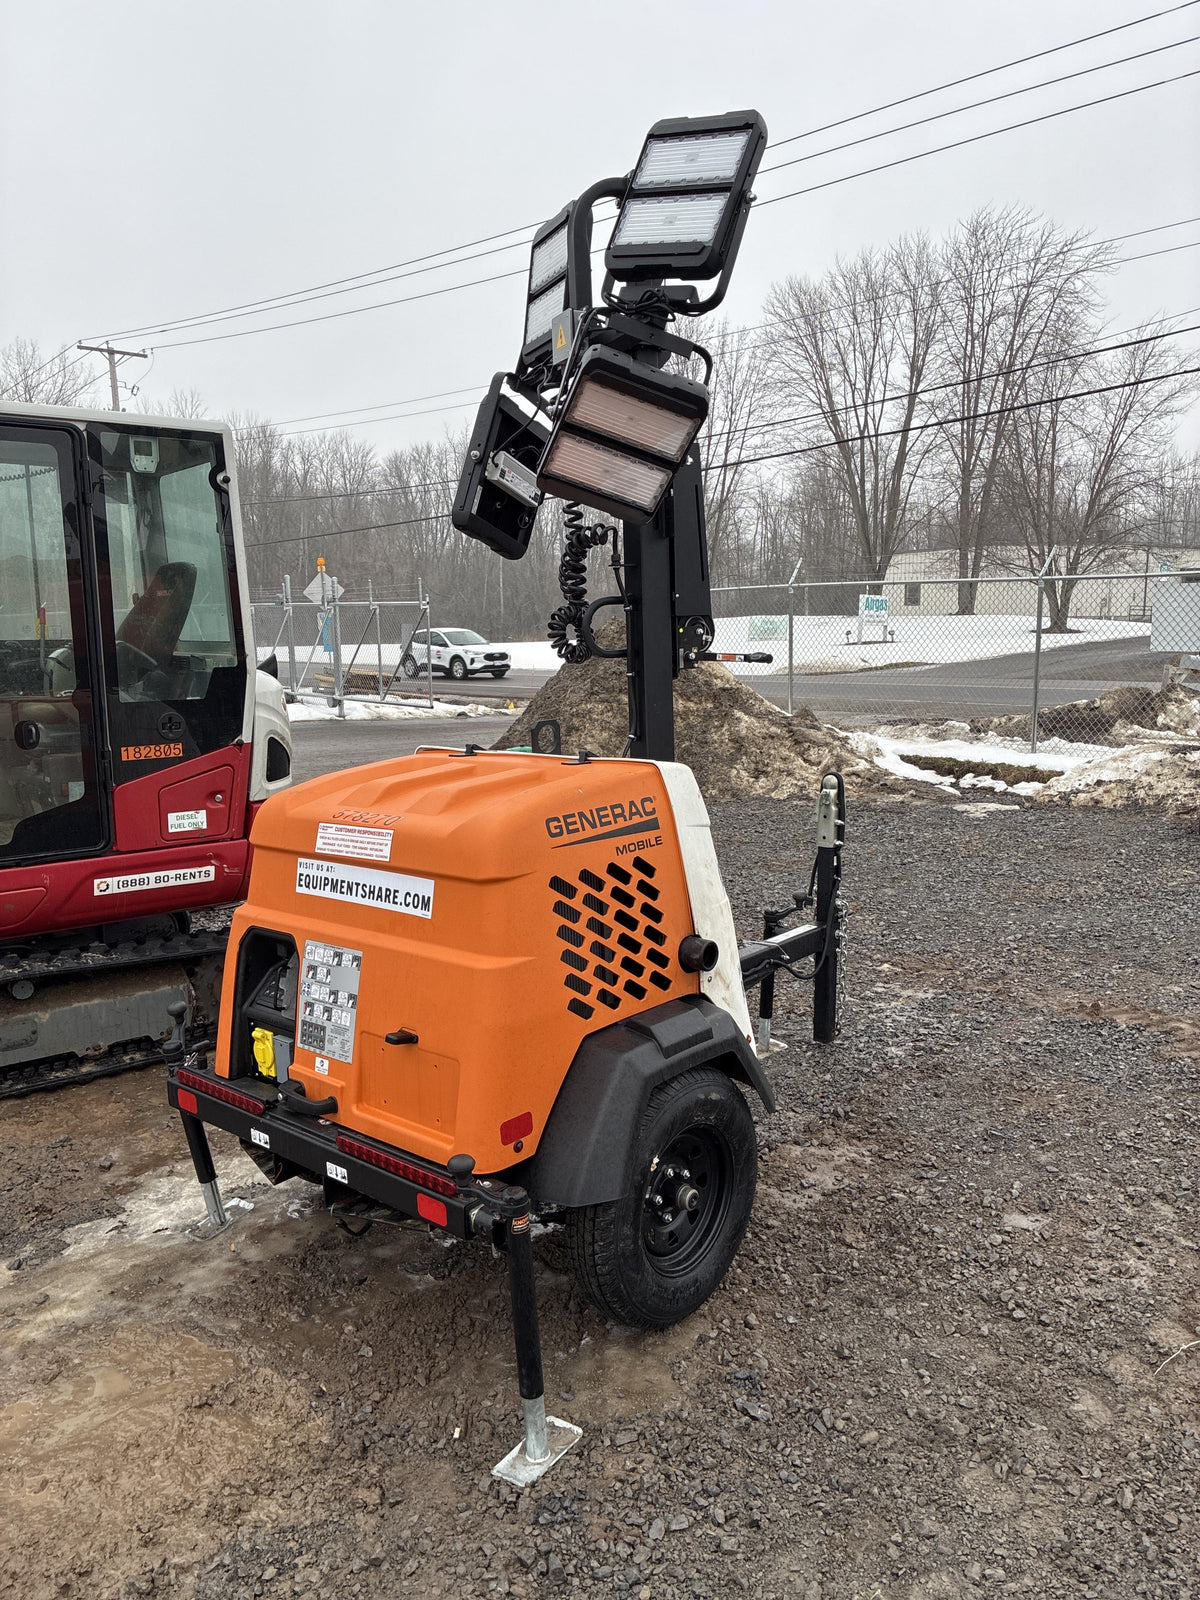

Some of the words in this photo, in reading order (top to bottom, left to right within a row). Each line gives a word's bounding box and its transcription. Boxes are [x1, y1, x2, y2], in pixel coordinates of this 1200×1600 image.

[865, 597, 888, 612] Airgas
[123, 744, 182, 760] 182805
[170, 822, 187, 830] FUEL
[187, 820, 204, 829] ONLY
[175, 813, 198, 821] DIESEL
[333, 810, 401, 826] 578270
[545, 796, 657, 838] GENERAC
[334, 826, 357, 834] CUSTOMER
[356, 828, 392, 838] RESPONSIBILITY
[615, 835, 663, 856] MOBILE
[299, 861, 314, 871] VISIT
[316, 863, 324, 872] US
[326, 865, 336, 873] AT:
[116, 876, 150, 890] (888)
[154, 869, 211, 885] 80-RENTS
[298, 872, 431, 912] EQUIPMENTSHARE.COM
